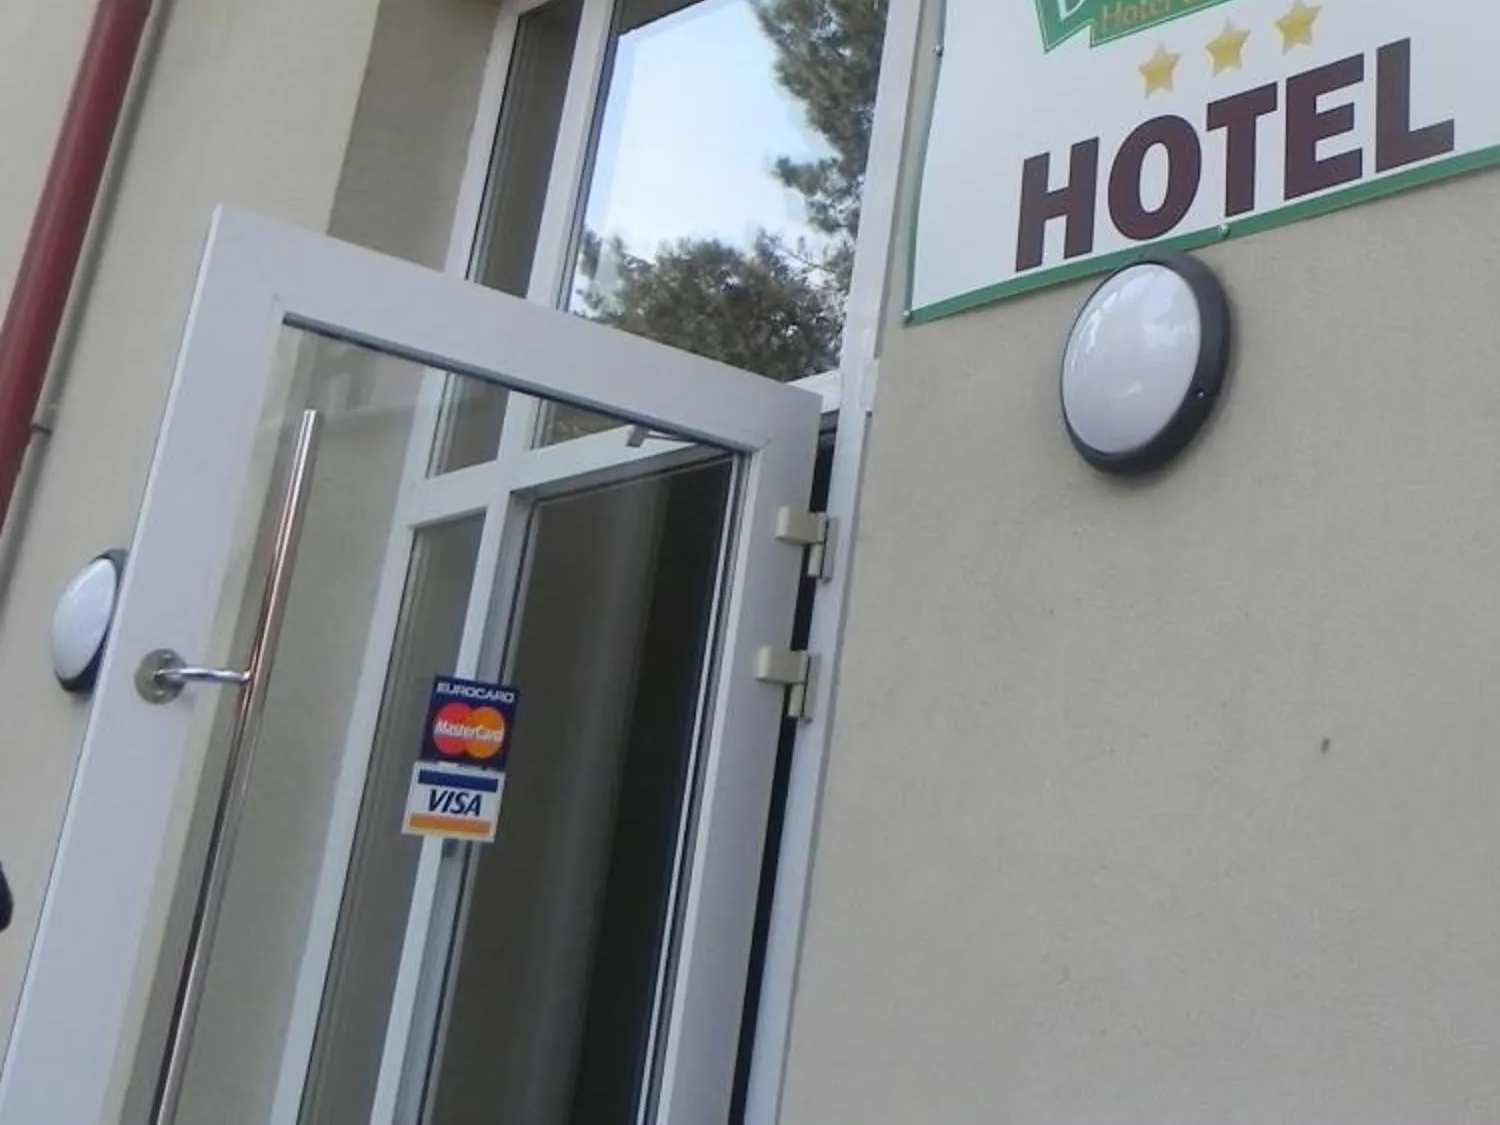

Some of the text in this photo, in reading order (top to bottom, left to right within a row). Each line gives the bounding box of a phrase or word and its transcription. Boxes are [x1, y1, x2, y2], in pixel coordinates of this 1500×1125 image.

[1015, 37, 1455, 273] HOTEL
[436, 682, 515, 704] EUROCARD
[433, 719, 505, 743] MasterCard
[428, 789, 483, 817] VISA
